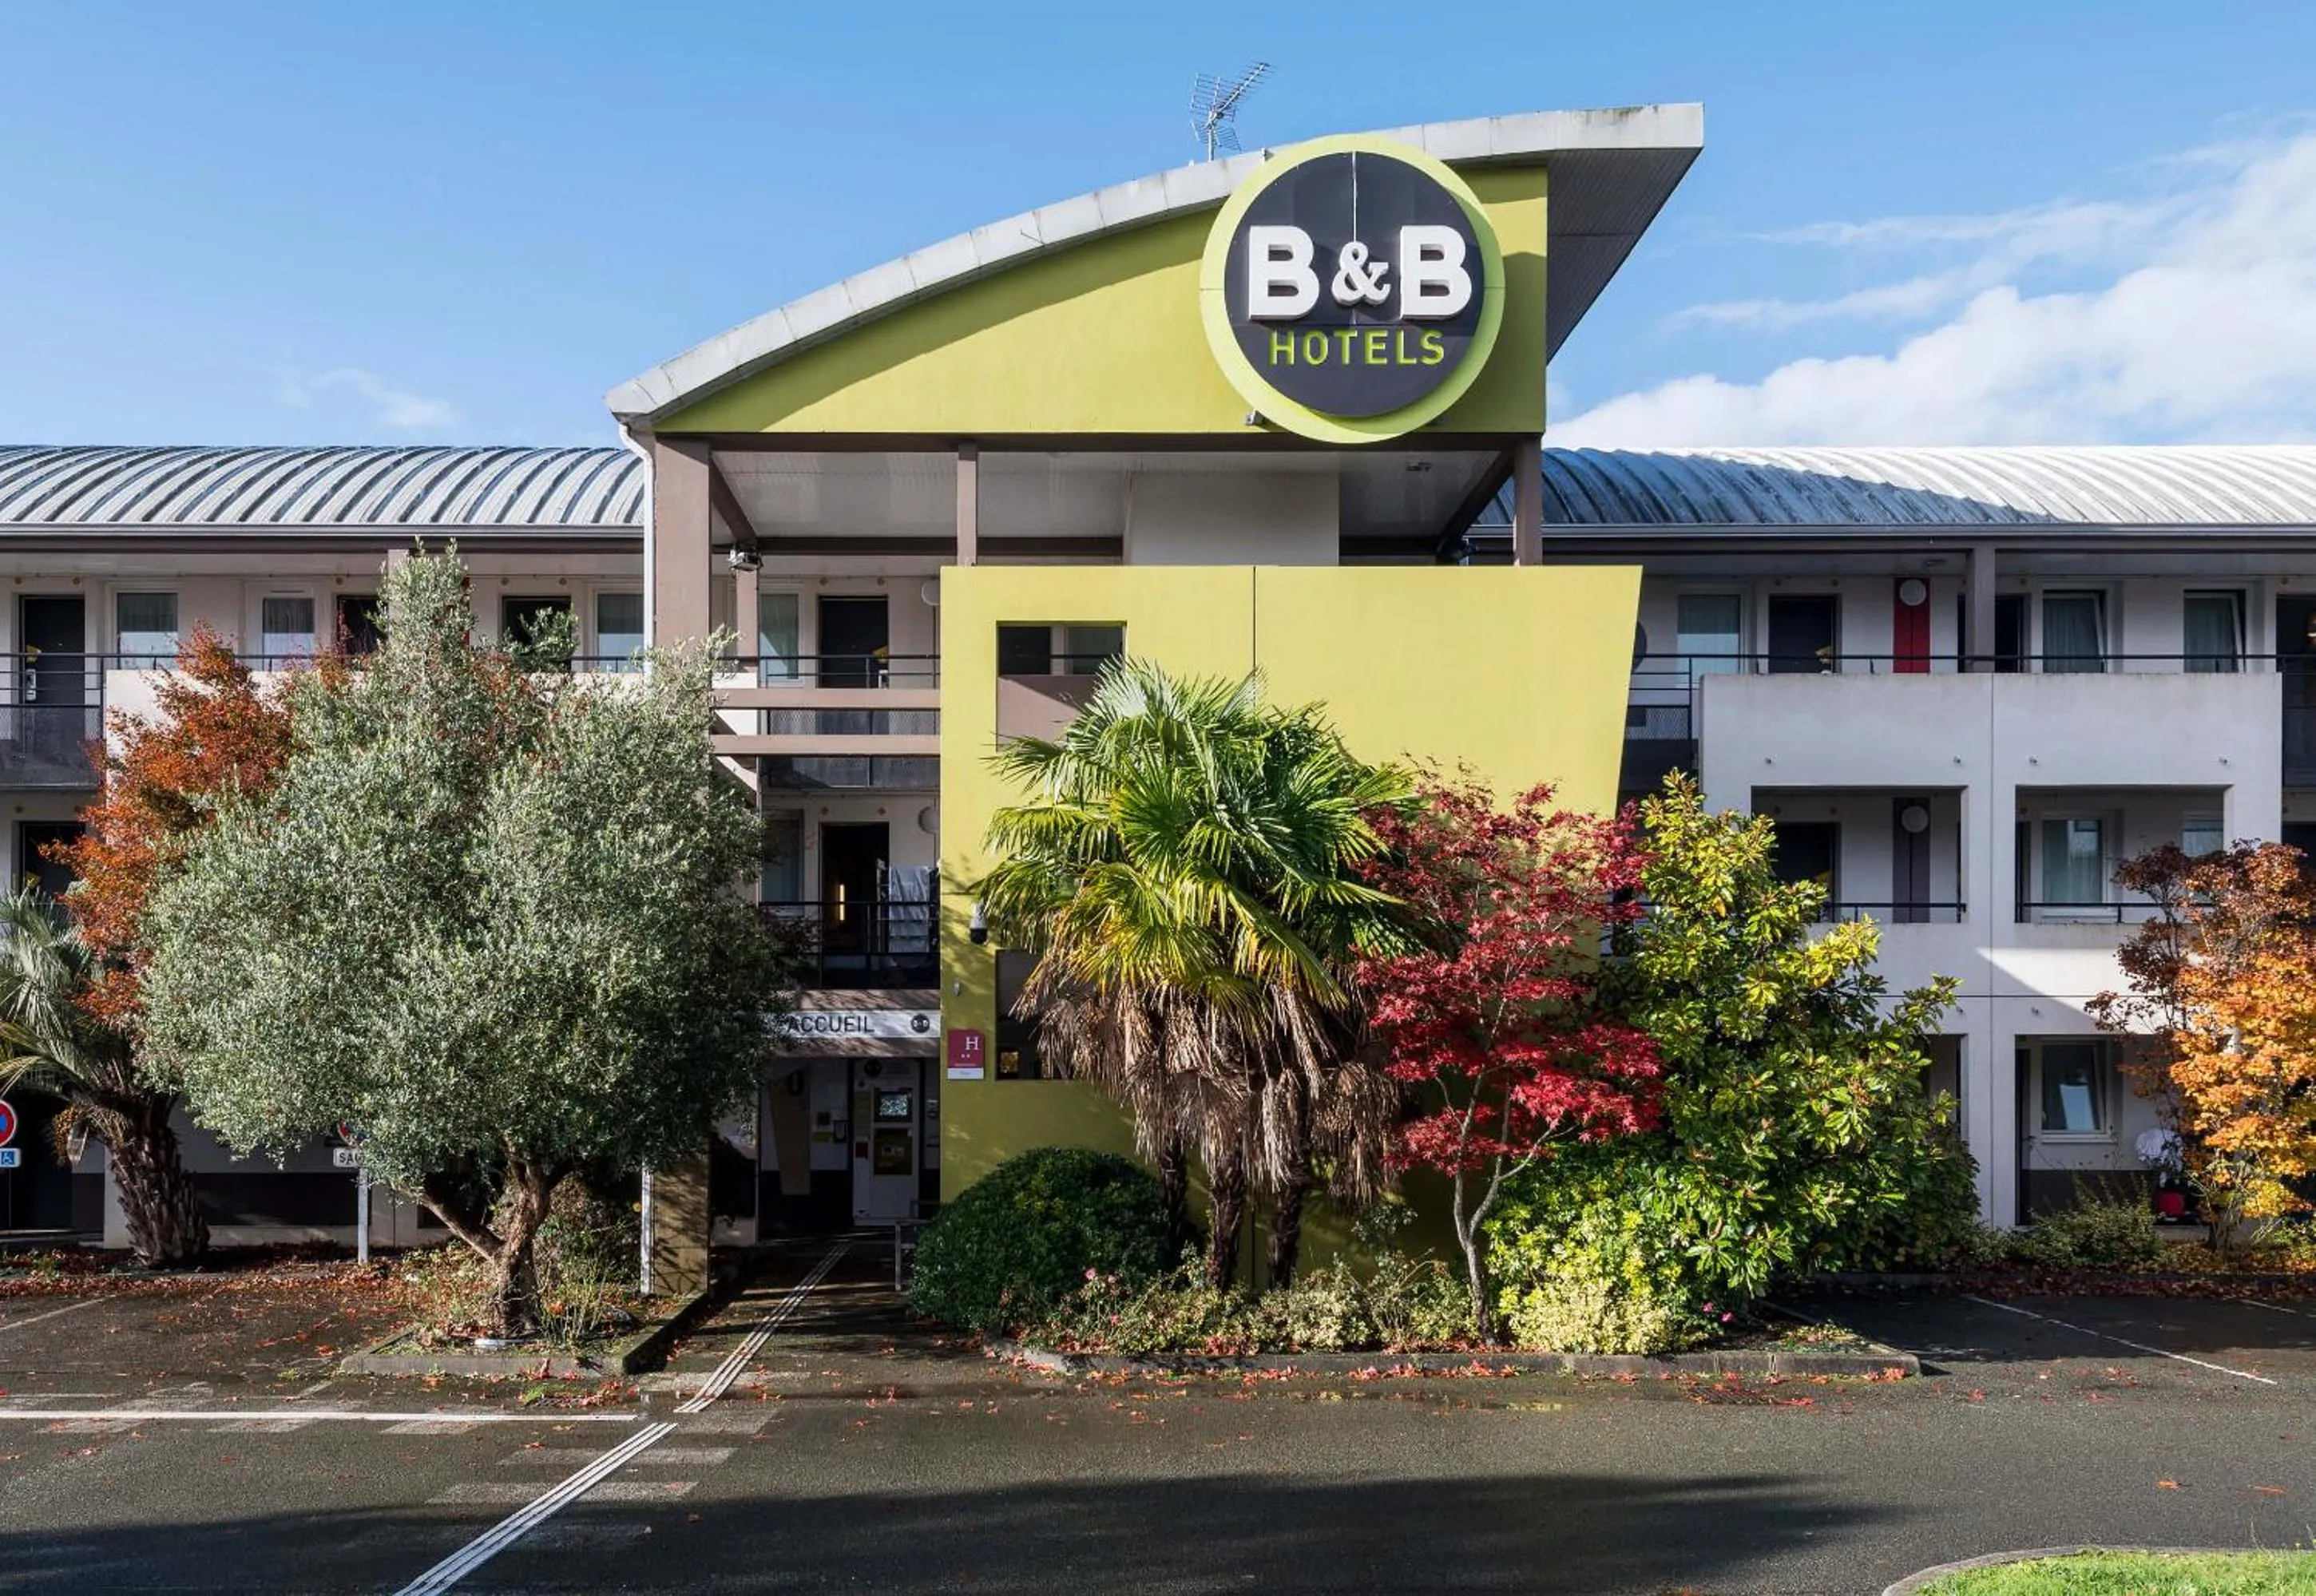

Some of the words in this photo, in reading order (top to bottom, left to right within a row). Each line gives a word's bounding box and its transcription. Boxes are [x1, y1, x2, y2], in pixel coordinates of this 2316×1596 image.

[1248, 224, 1473, 320] B&B
[1268, 328, 1445, 366] HOTELS
[787, 1015, 875, 1033] ACCUEIL
[965, 1036, 979, 1051] H
